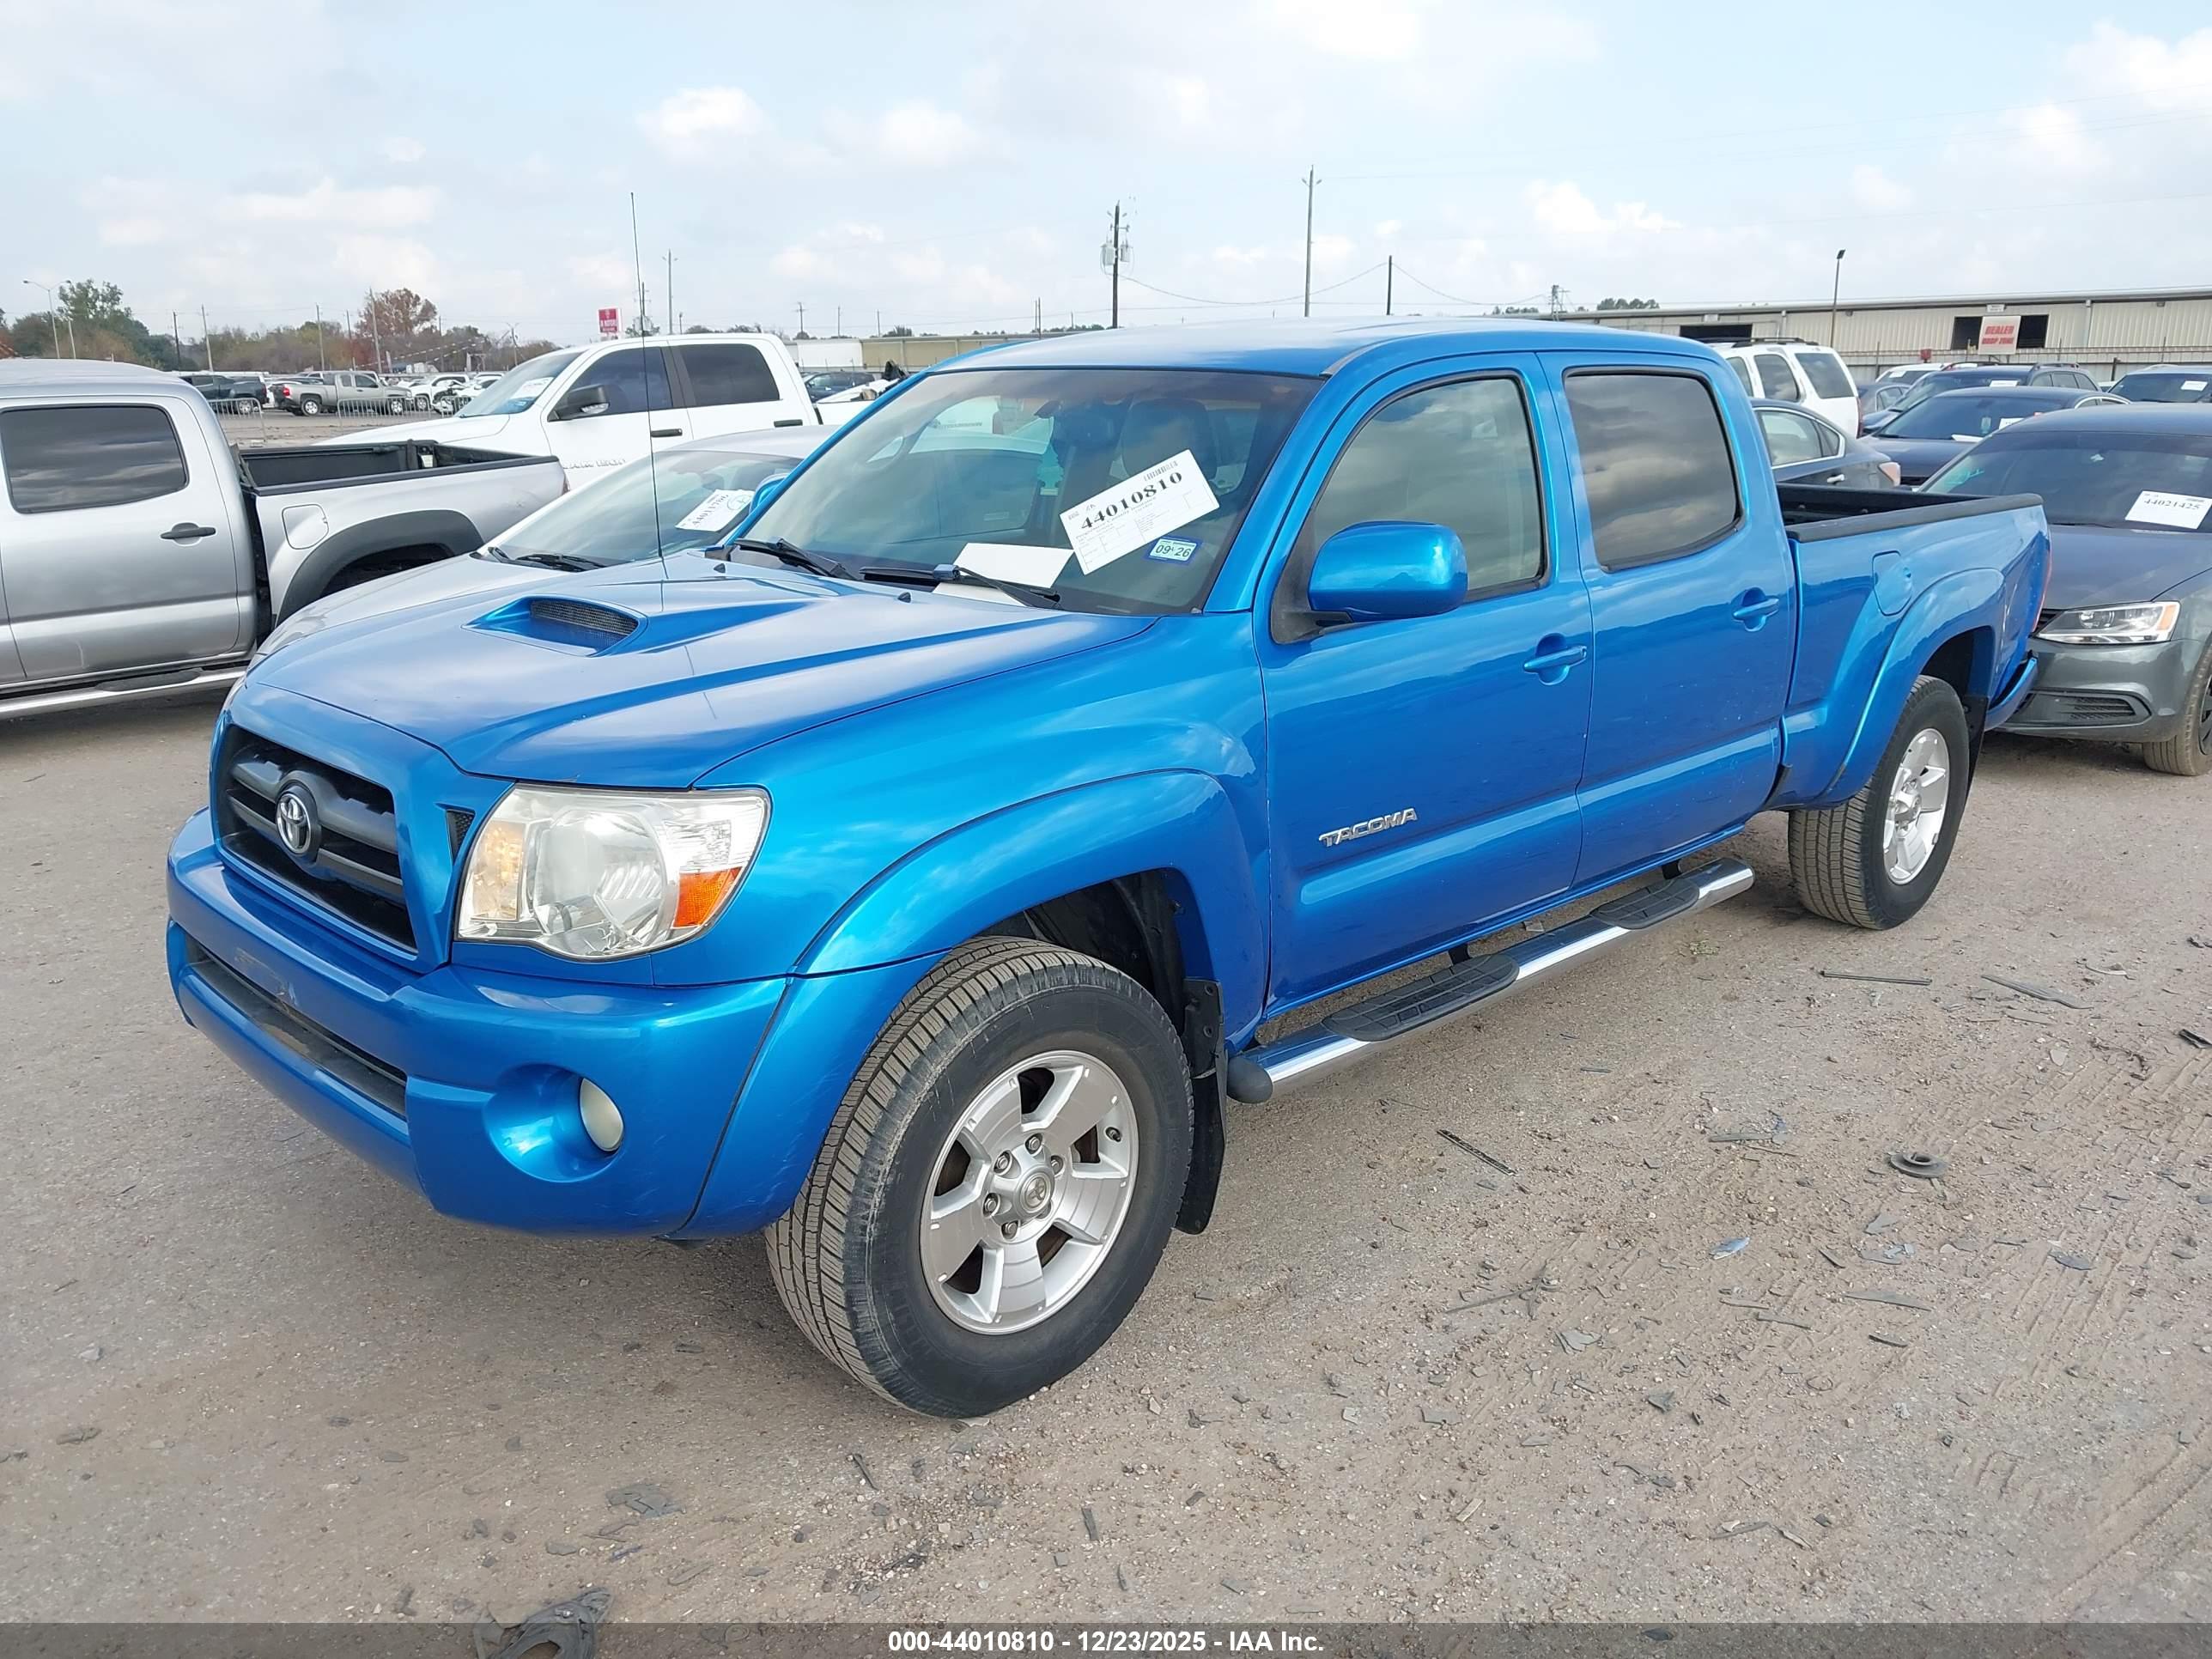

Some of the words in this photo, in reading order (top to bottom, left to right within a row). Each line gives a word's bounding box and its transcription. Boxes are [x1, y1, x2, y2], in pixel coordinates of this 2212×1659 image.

[1081, 471, 1182, 530] 44010810
[1155, 544, 1170, 555] 09
[1174, 547, 1191, 557] 26
[1319, 807, 1418, 847] TACOMA
